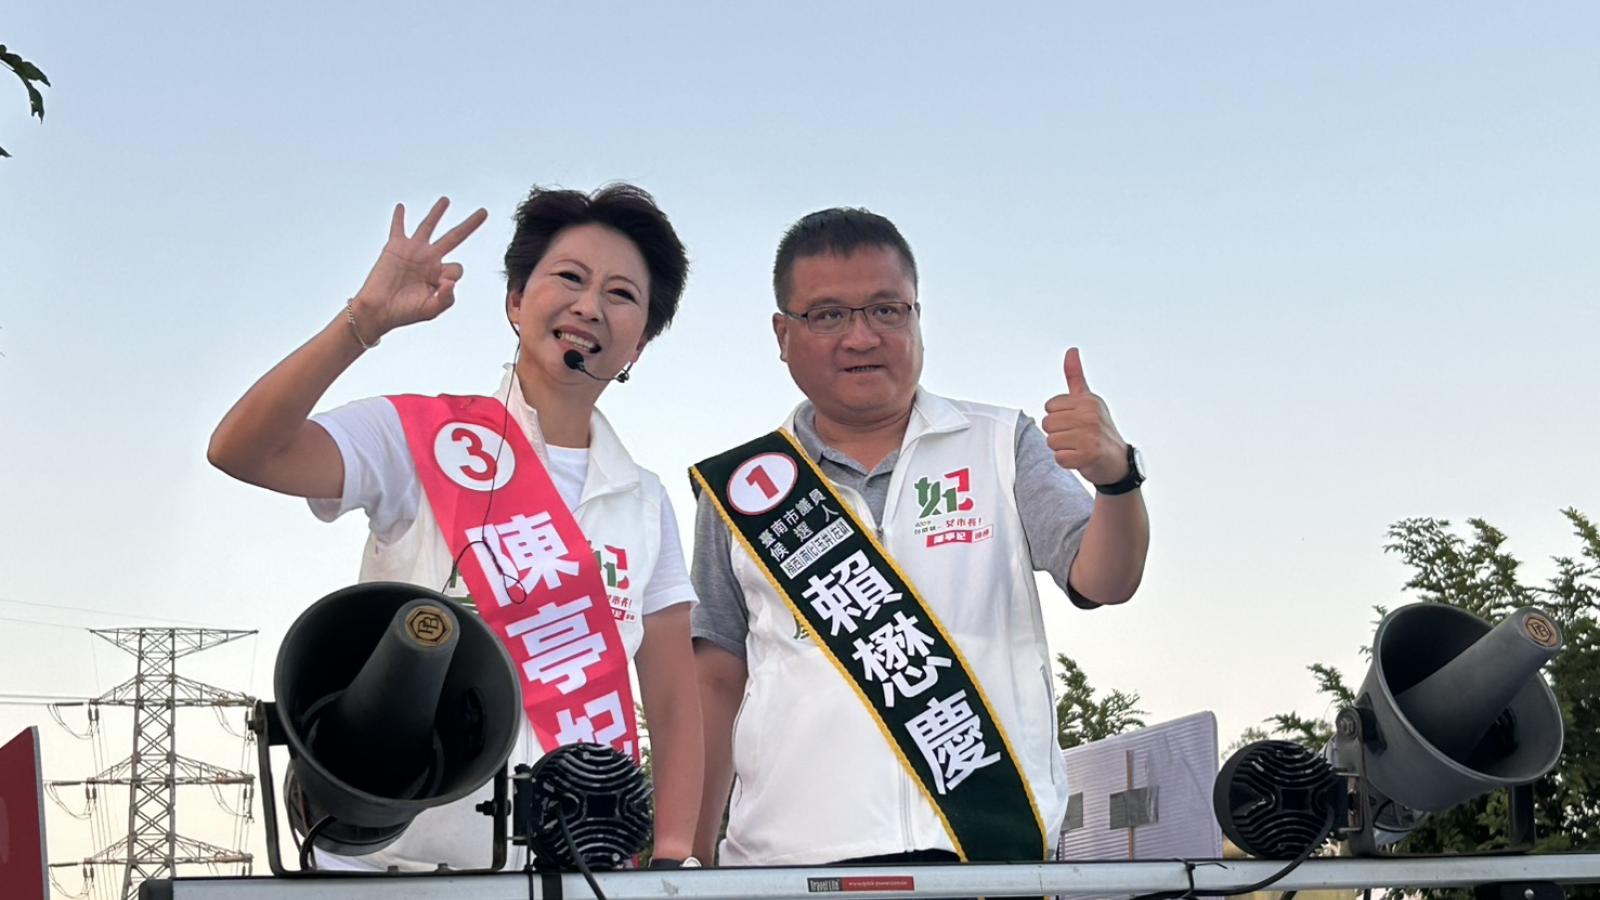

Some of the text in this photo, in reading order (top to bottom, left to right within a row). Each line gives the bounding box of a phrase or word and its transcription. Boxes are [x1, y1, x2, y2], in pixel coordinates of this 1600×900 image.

[452, 427, 496, 481] 3
[745, 464, 779, 500] 1
[801, 549, 1001, 795] 賴懋慶
